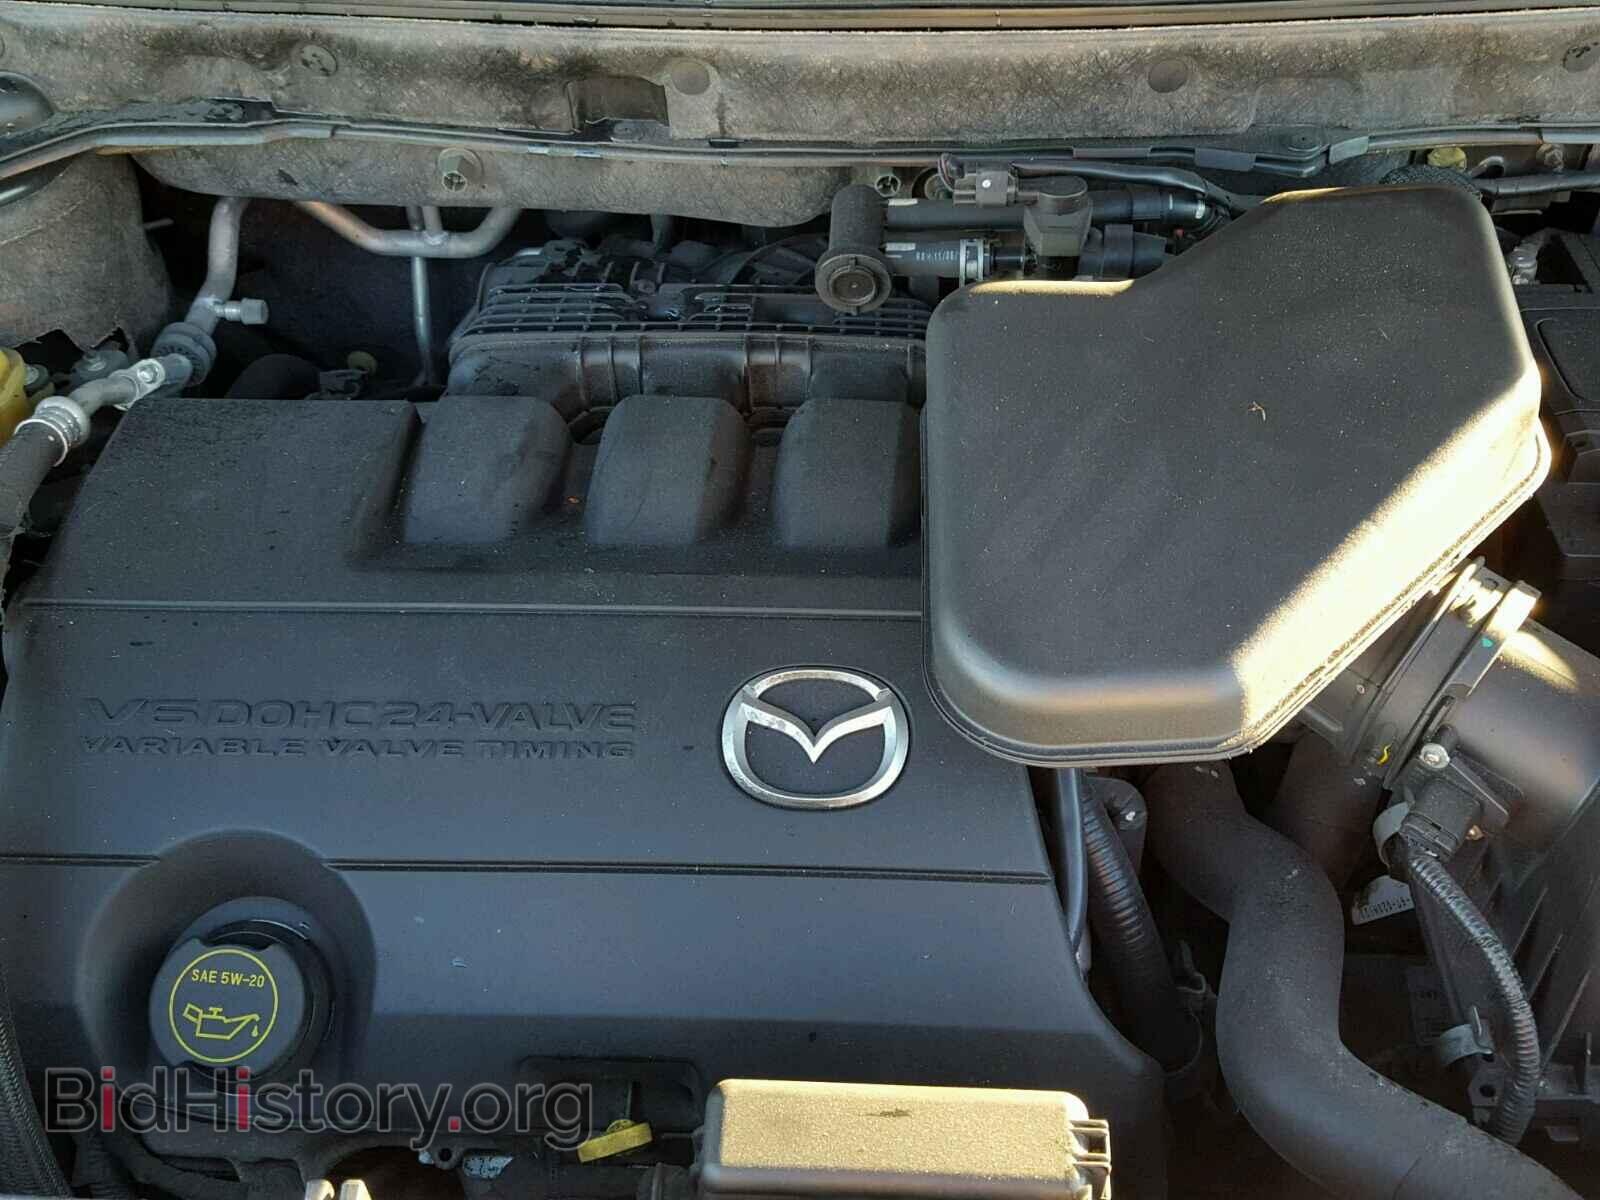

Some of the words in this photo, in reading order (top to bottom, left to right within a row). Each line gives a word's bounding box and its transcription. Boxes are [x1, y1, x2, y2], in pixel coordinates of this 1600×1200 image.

[80, 697, 201, 728] V6
[207, 698, 377, 729] DOHC
[380, 700, 638, 732] 24-VALVE
[79, 734, 307, 757] VARIABLE
[319, 737, 465, 760] VALVE
[472, 739, 634, 760] TIMING
[191, 968, 218, 984] SAE
[220, 971, 266, 988] 5W-20
